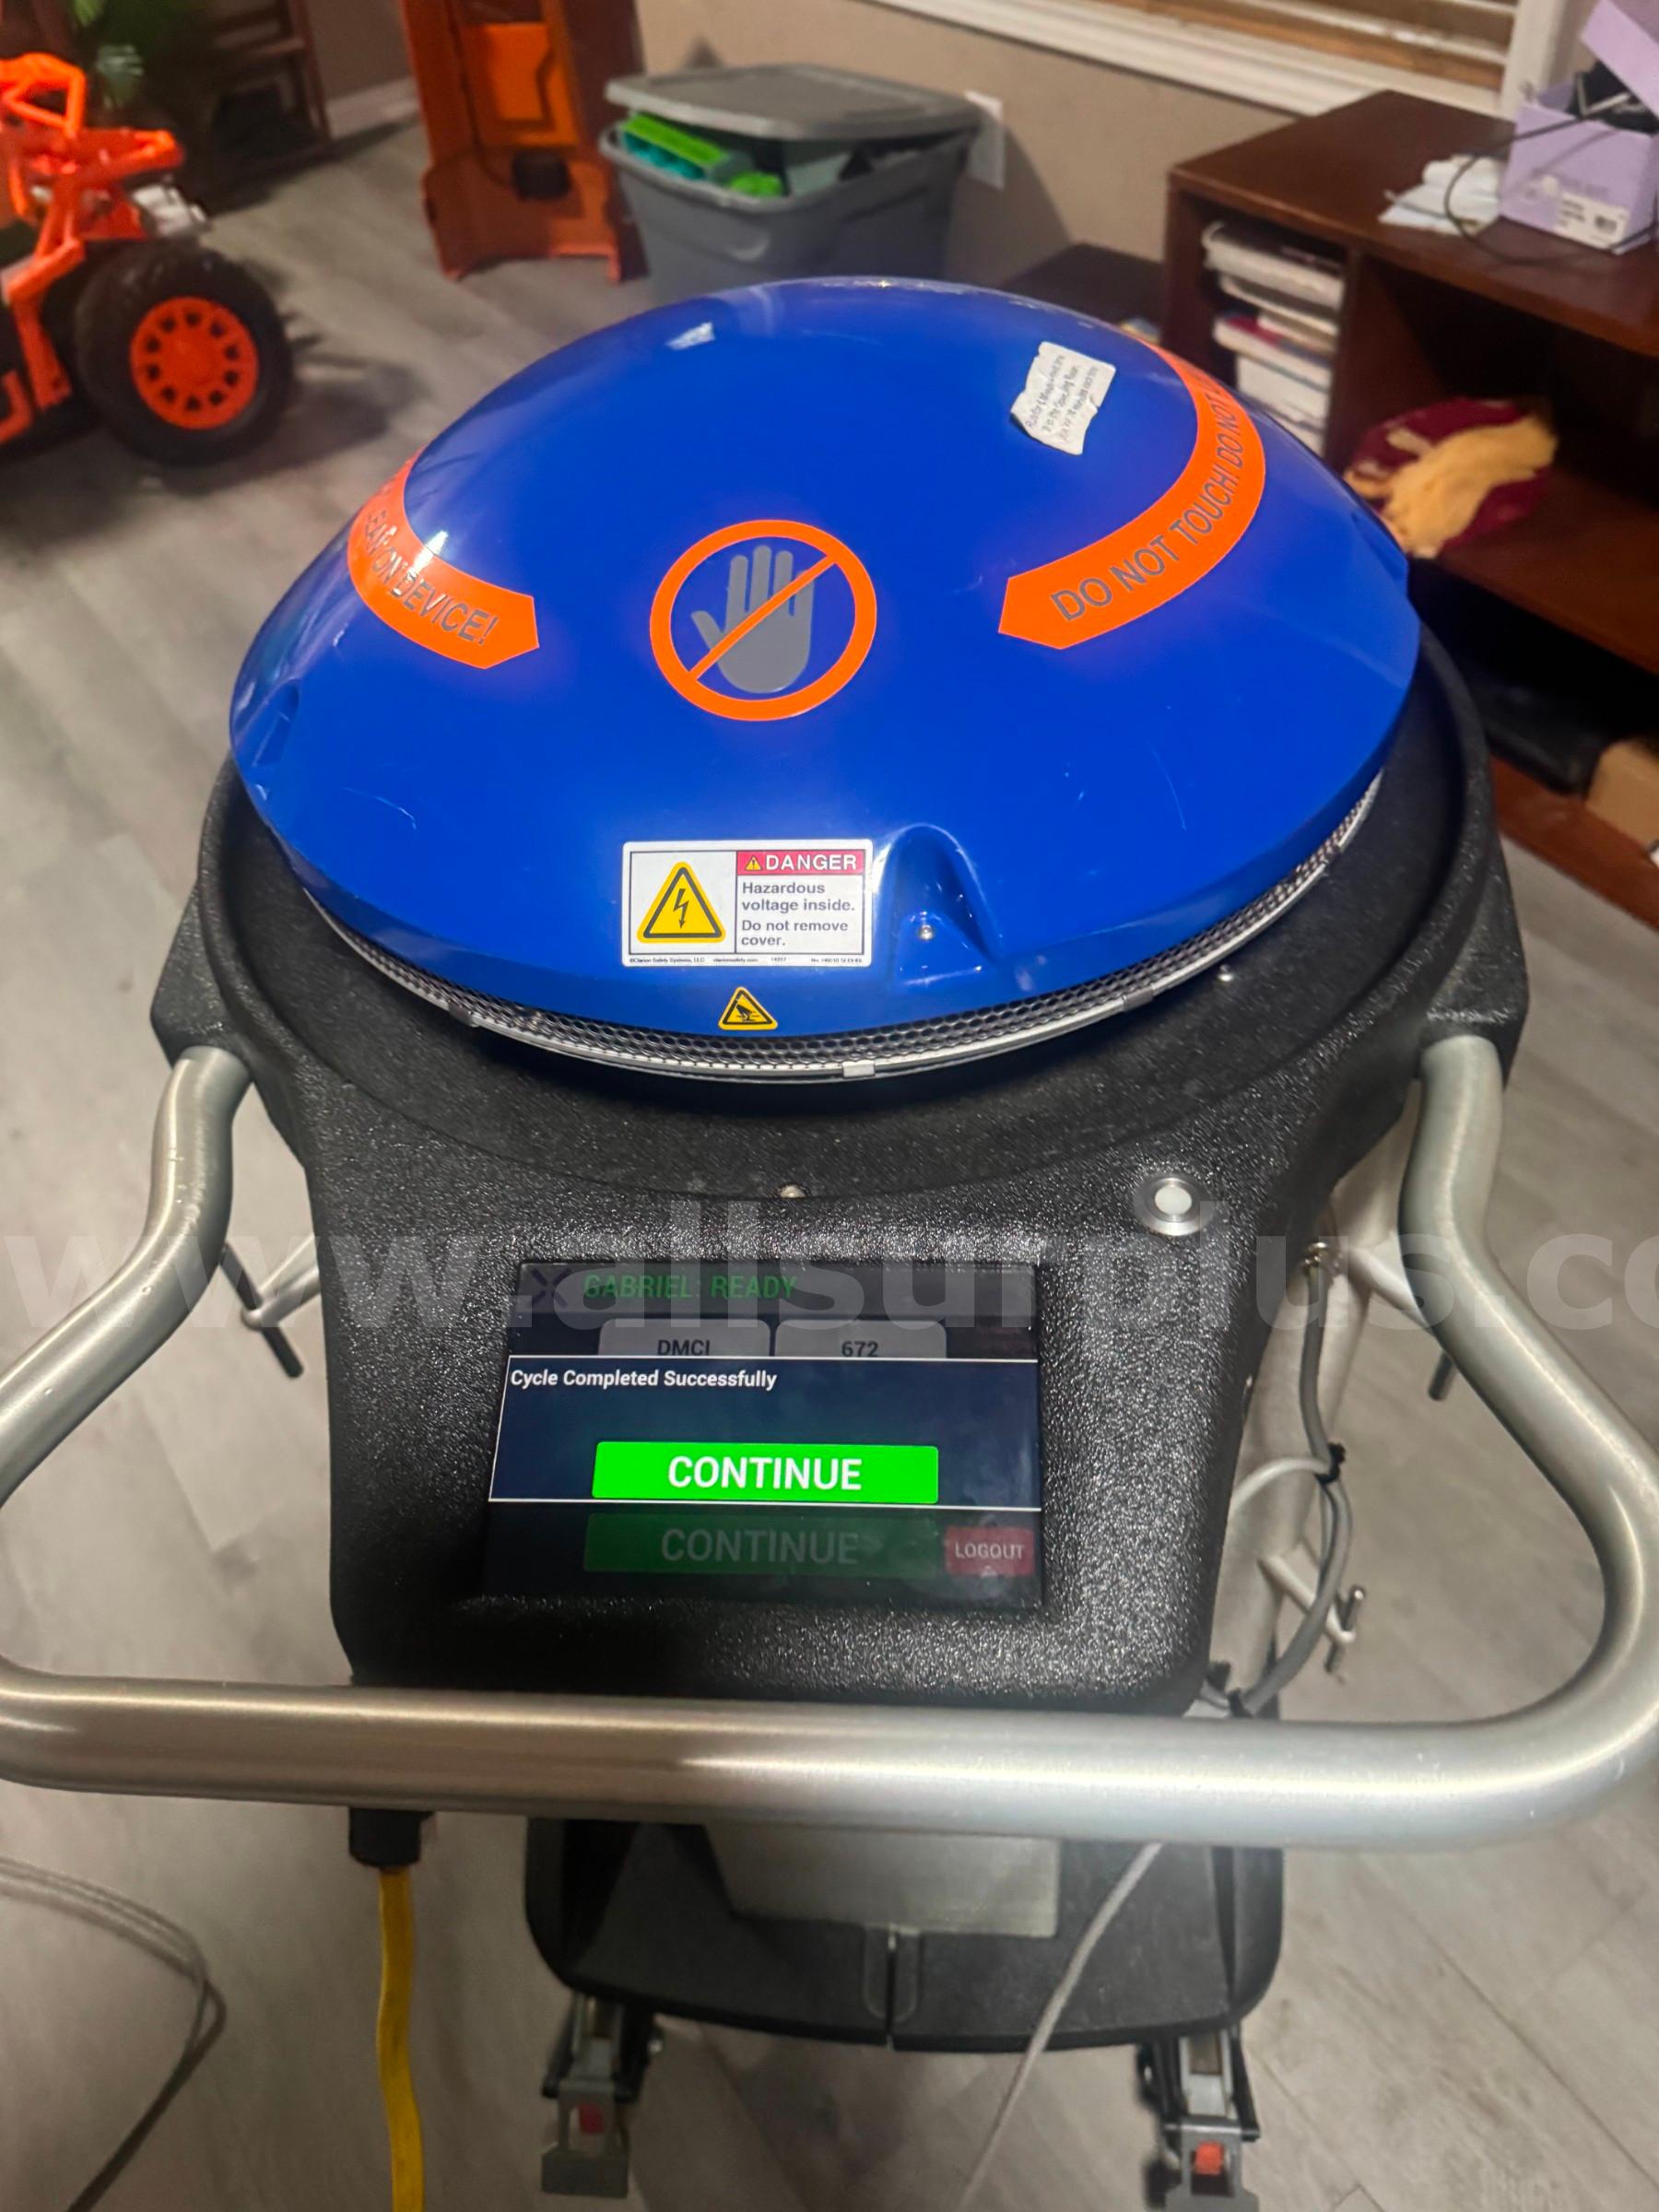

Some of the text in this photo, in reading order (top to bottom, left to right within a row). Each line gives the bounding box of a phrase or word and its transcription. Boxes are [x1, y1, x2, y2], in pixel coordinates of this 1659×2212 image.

[1049, 577, 1113, 622] DO
[1109, 535, 1181, 592] NOT
[1168, 464, 1241, 546] TOUCH!
[1217, 432, 1243, 469] DO
[390, 569, 500, 645] DEVICE!
[765, 854, 857, 871] DANGER
[742, 881, 826, 894] Hazardous
[741, 899, 855, 913] voltage inside.
[741, 920, 849, 932] Do not remove
[741, 936, 786, 947] cover.
[710, 1275, 797, 1300] READY
[657, 1339, 711, 1357] DMCI
[841, 1341, 878, 1358] 672
[510, 1370, 777, 1391] Cycle Completed Successfully
[668, 1455, 863, 1491] CONTINUE
[661, 1528, 860, 1565] CONTINUE
[955, 1542, 1025, 1561] LOGOUT
